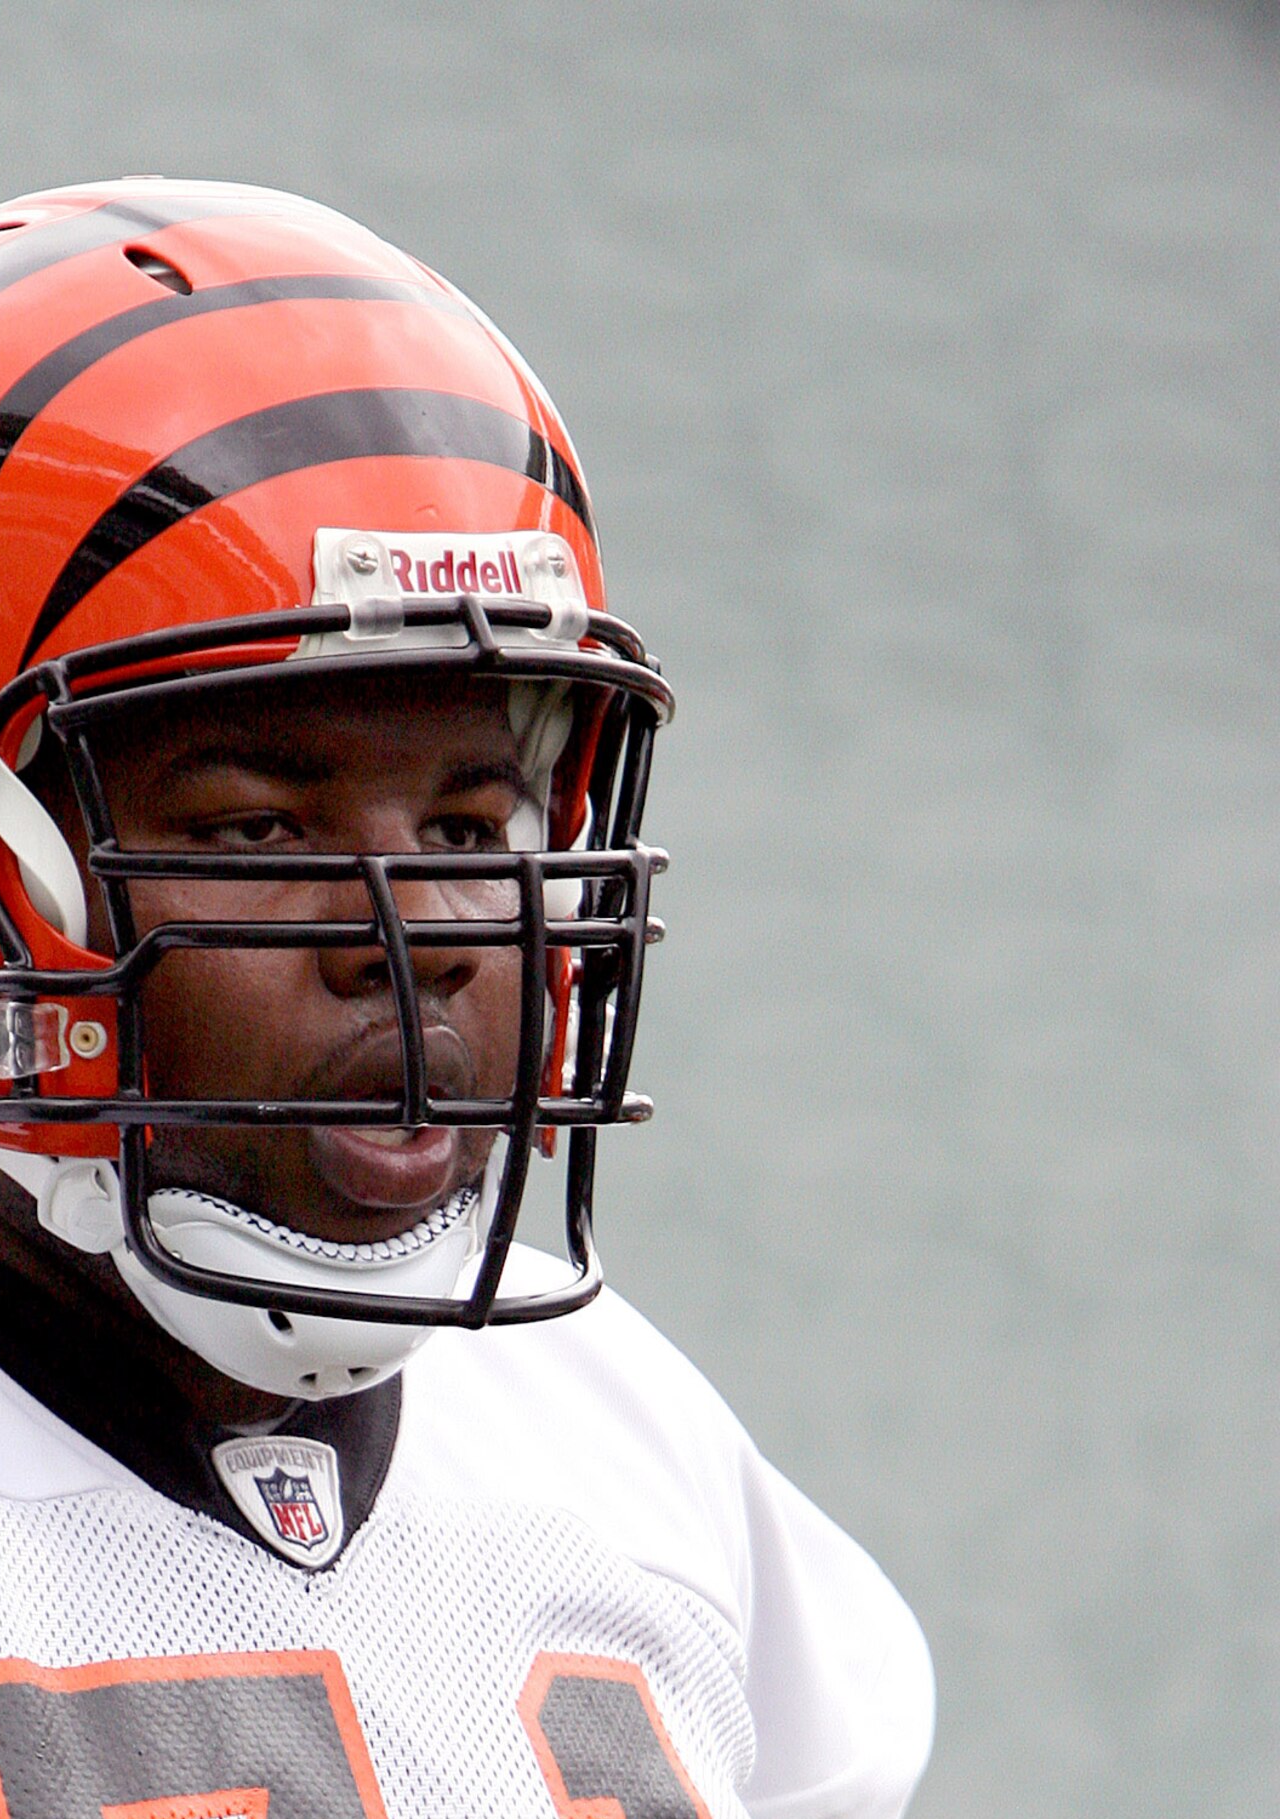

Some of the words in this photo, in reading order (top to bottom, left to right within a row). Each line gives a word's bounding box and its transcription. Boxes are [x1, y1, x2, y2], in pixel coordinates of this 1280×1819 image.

[388, 548, 523, 594] Riddell
[224, 1445, 326, 1474] EQUIPMENT
[272, 1502, 323, 1541] NFL
